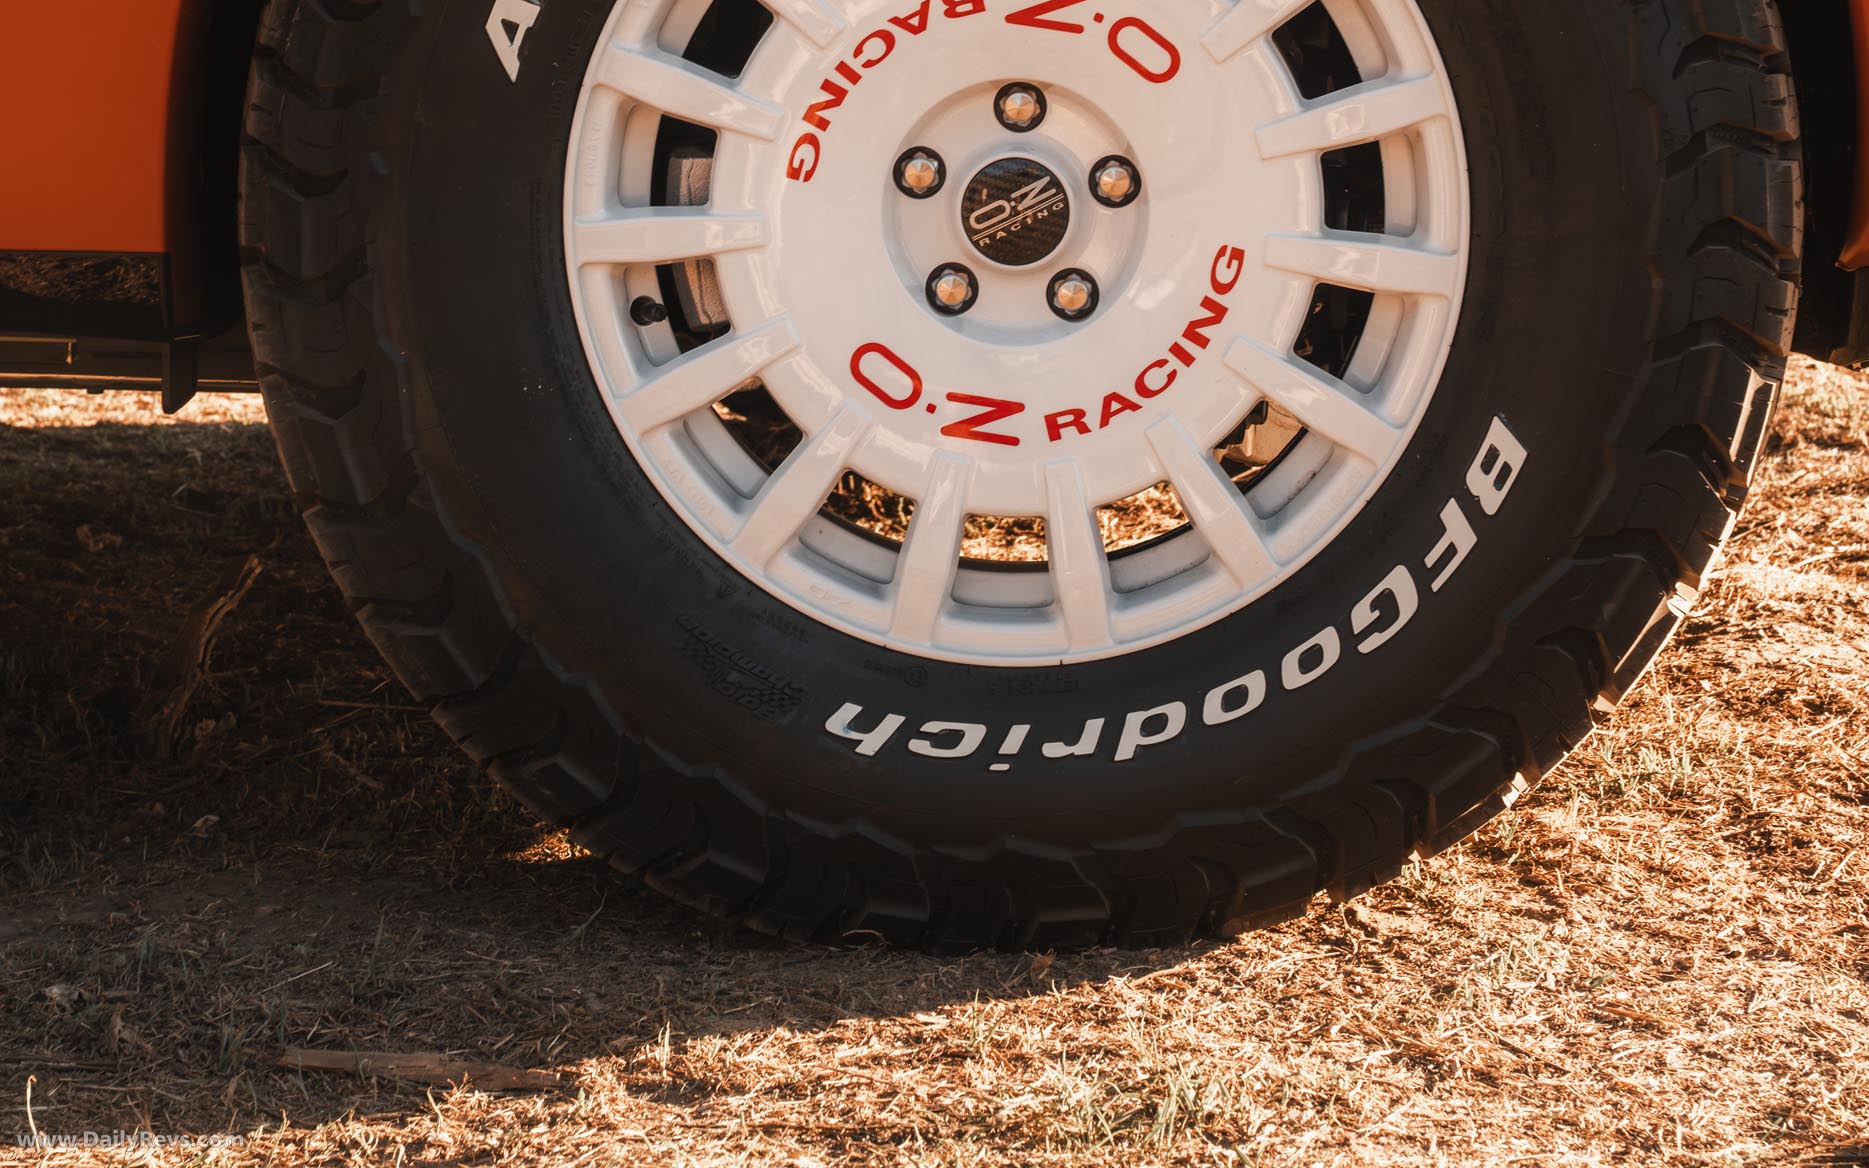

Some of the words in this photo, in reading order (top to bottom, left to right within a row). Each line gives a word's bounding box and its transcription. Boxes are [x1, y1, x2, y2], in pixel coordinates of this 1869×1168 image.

[978, 201, 1064, 247] RACING
[1042, 243, 1247, 444] RACING
[822, 413, 1529, 773] BFGoodrich
